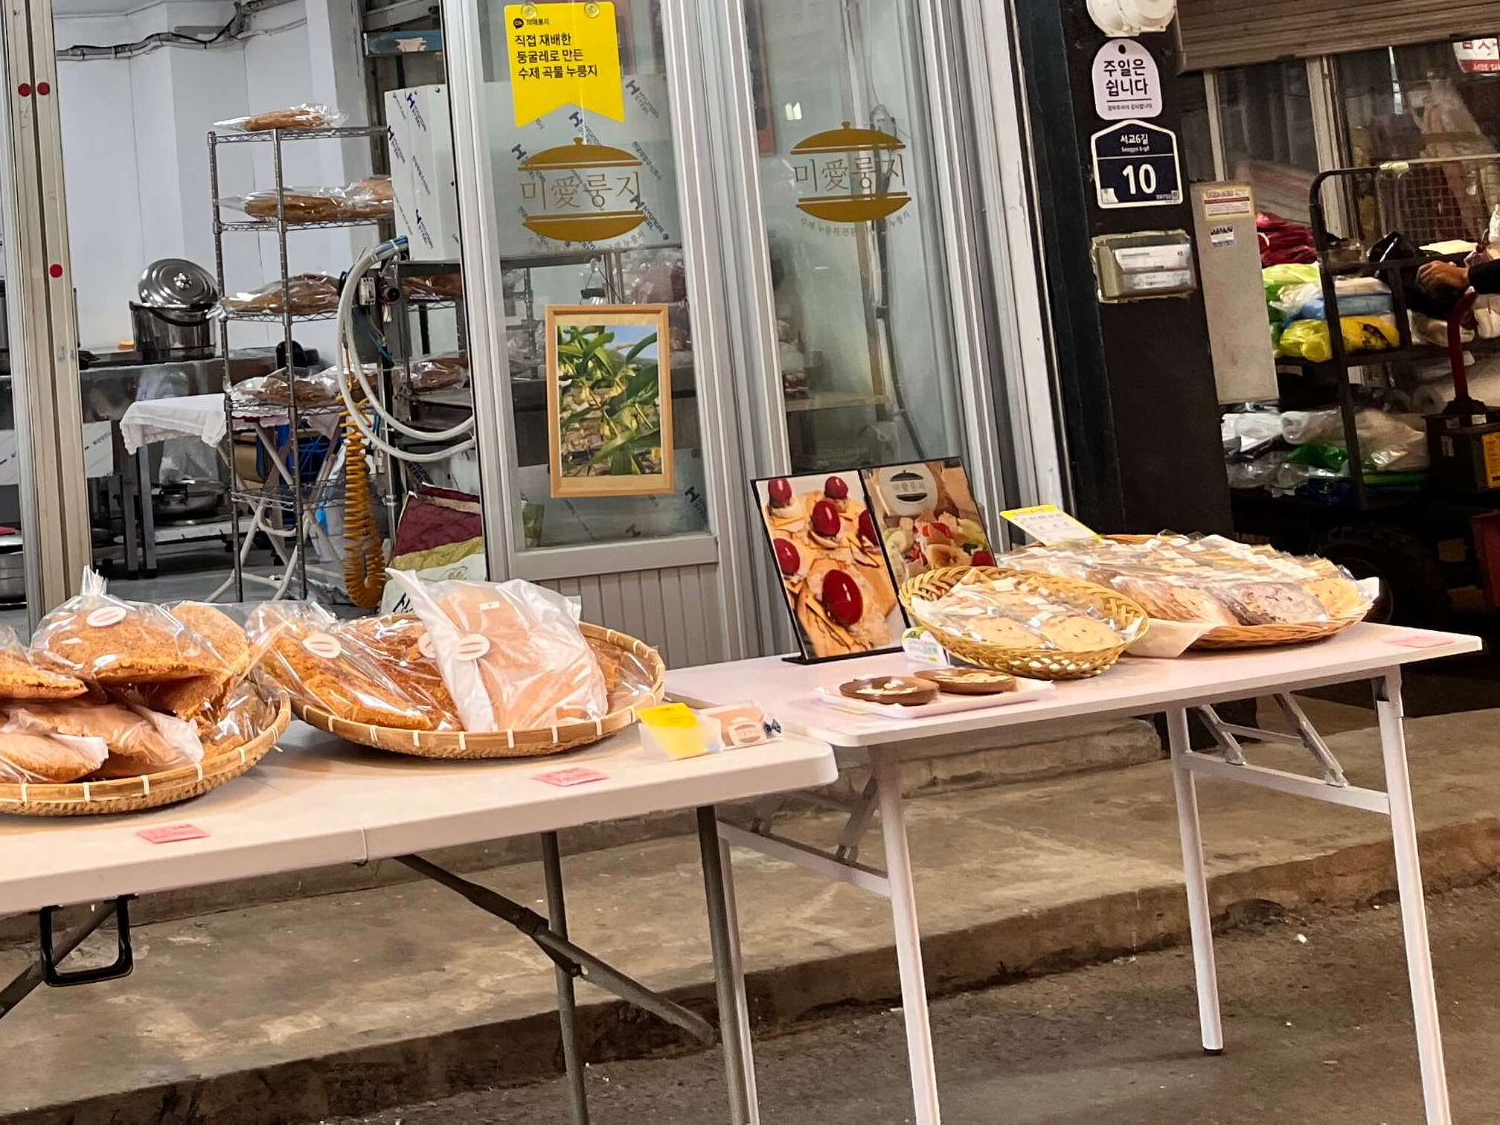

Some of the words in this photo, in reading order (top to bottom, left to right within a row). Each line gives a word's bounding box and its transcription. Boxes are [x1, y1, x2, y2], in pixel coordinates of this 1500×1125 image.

[515, 33, 537, 47] 직접
[539, 32, 572, 46] 재배한
[516, 50, 561, 64] 둥굴레로
[562, 49, 584, 62] 만든
[518, 67, 540, 80] 수제
[542, 66, 564, 79] 곡물
[566, 64, 598, 77] 누룽지
[1103, 58, 1146, 78] 주일은
[1105, 77, 1149, 97] 쉽니다
[1122, 163, 1157, 195] 10
